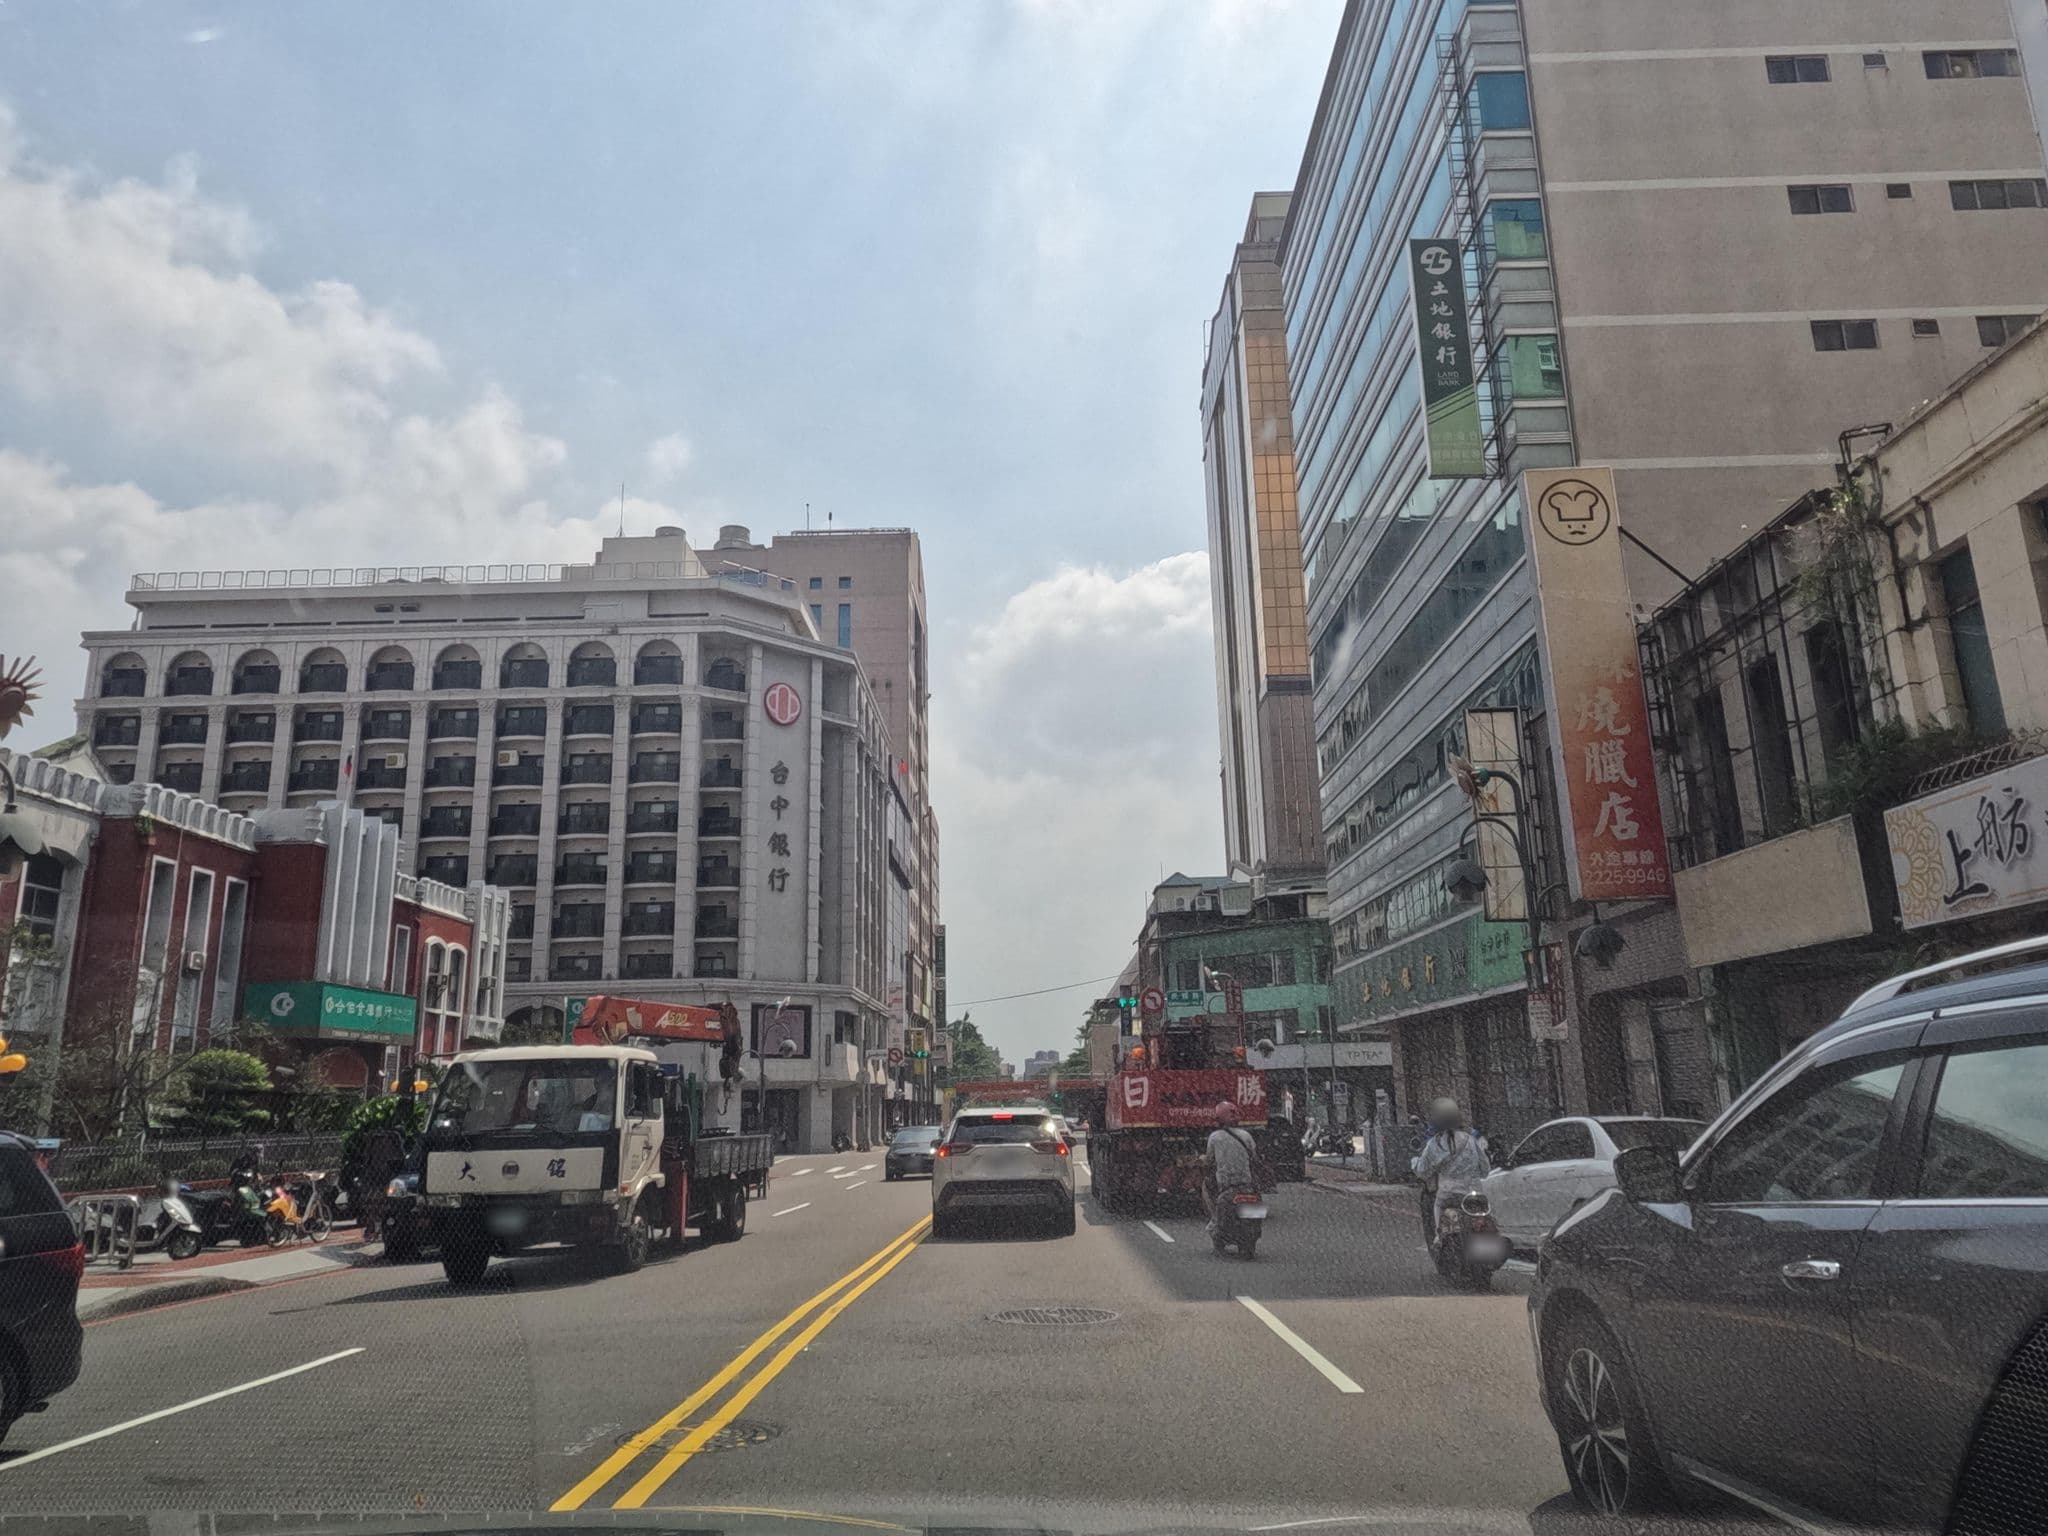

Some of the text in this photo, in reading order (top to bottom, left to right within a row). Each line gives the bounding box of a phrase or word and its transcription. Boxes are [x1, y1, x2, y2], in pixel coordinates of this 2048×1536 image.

[1429, 280, 1457, 366] 土地銀行
[767, 759, 791, 893] 台中銀行
[1943, 786, 2048, 905] 上舫
[1237, 1075, 1267, 1106] 勝
[458, 1157, 567, 1182] 大 銘
